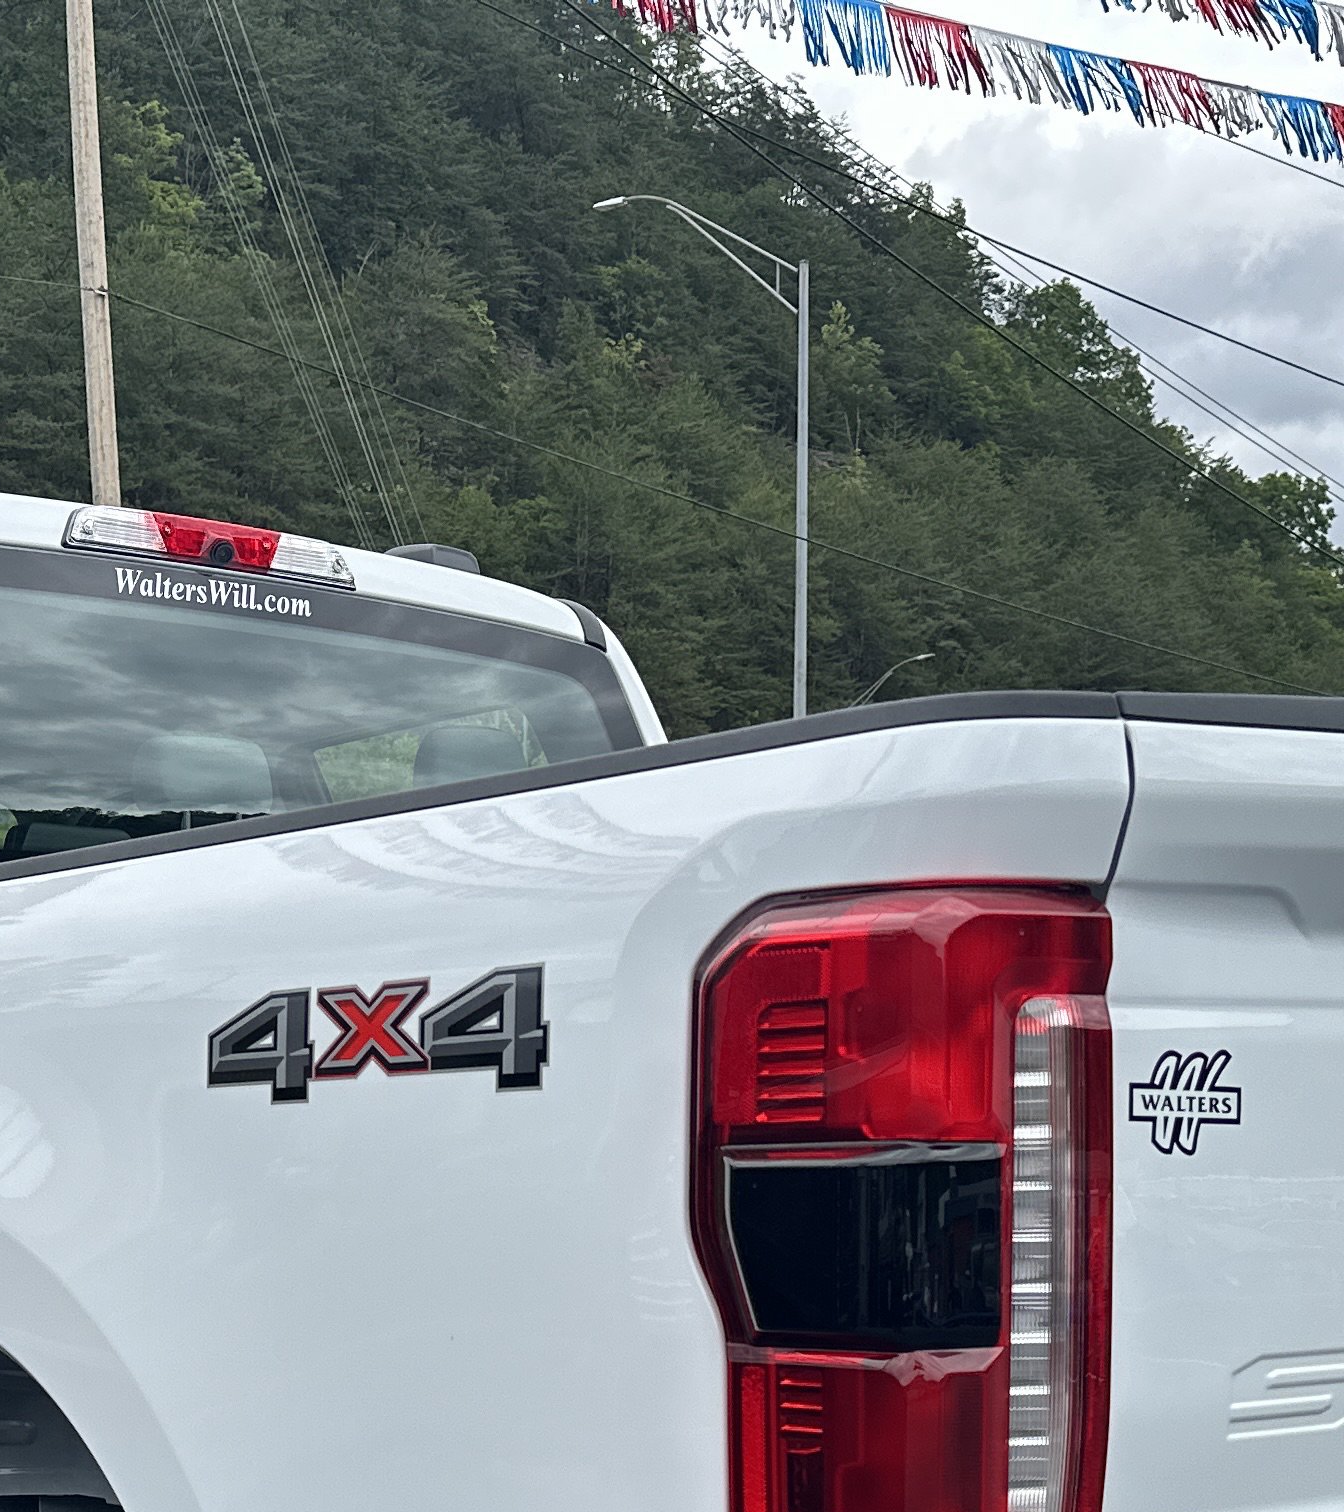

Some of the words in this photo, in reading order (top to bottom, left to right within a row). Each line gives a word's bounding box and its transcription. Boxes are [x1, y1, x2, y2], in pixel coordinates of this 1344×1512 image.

[114, 566, 313, 618] WaltersWill.com
[207, 962, 550, 1105] 4X4
[1141, 1093, 1233, 1114] WALTERS
